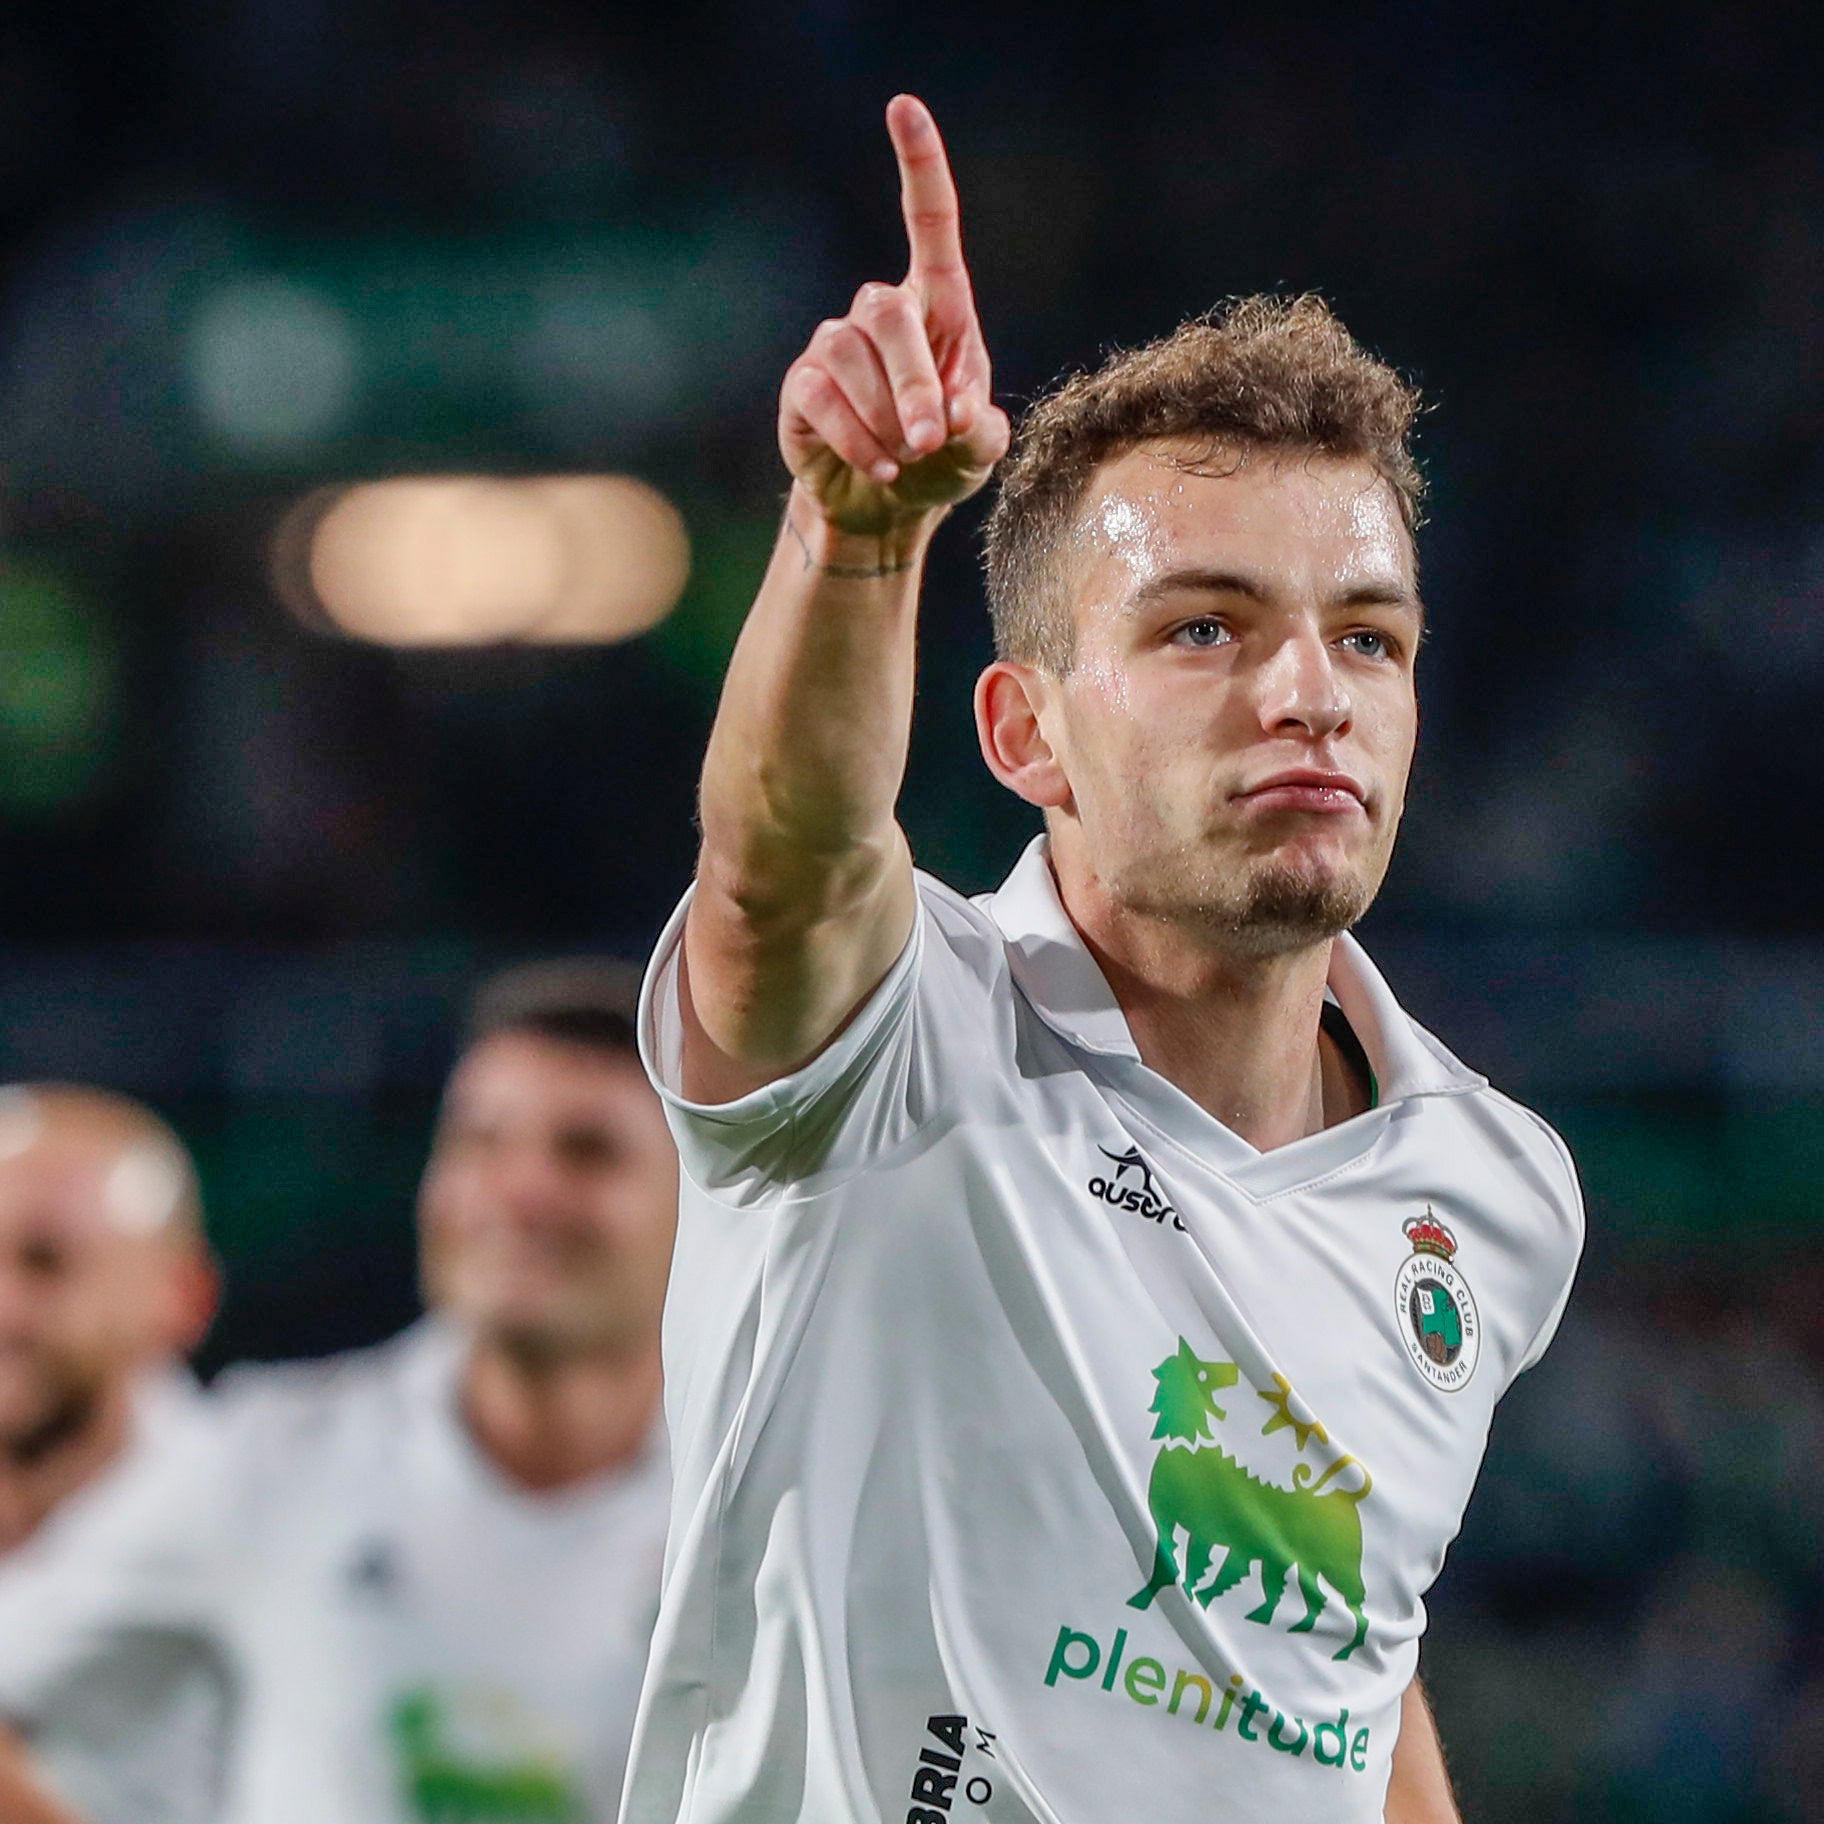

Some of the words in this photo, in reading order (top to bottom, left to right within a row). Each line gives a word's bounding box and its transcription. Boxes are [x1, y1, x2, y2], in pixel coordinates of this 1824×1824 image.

[1400, 1275, 1412, 1313] REAL
[1411, 1261, 1455, 1287] RACING
[1456, 1290, 1474, 1337] CLUB
[1411, 1342, 1468, 1385] SANTANDER
[1044, 1625, 1370, 1772] plenitude
